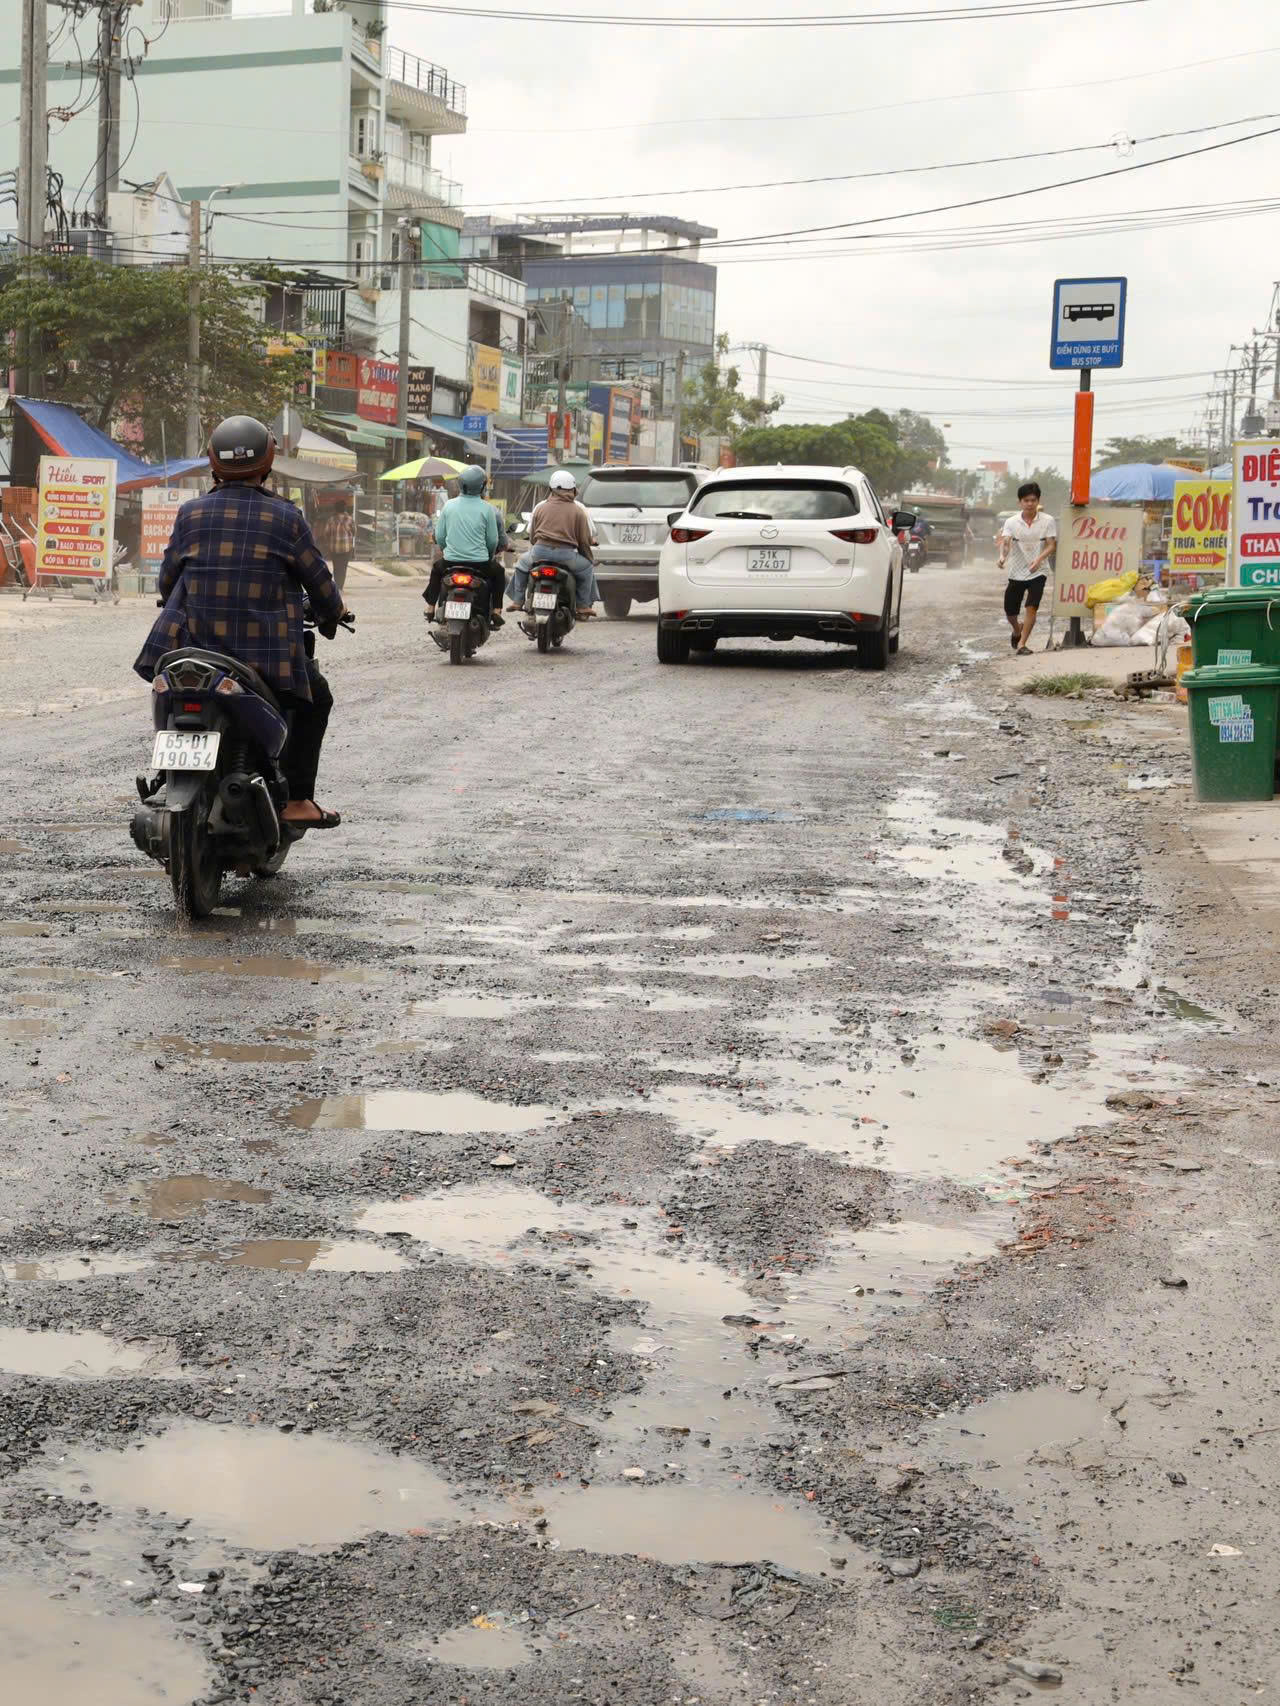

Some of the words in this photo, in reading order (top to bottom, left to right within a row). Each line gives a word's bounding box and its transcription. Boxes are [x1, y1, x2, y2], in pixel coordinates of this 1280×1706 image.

[1092, 345, 1100, 354] XE
[1072, 357, 1084, 366] BUS
[1085, 357, 1102, 366] STOP
[82, 475, 106, 485] SPORT
[1176, 486, 1231, 532] CƠM
[58, 526, 80, 534] VALI
[1072, 516, 1127, 541] Bán
[1173, 535, 1195, 549] TRƯA
[759, 550, 778, 559] 51K
[1072, 544, 1099, 570] BẢO
[1104, 545, 1123, 576] HỘ
[1059, 583, 1086, 603] LAO
[158, 751, 212, 768] 190.54
